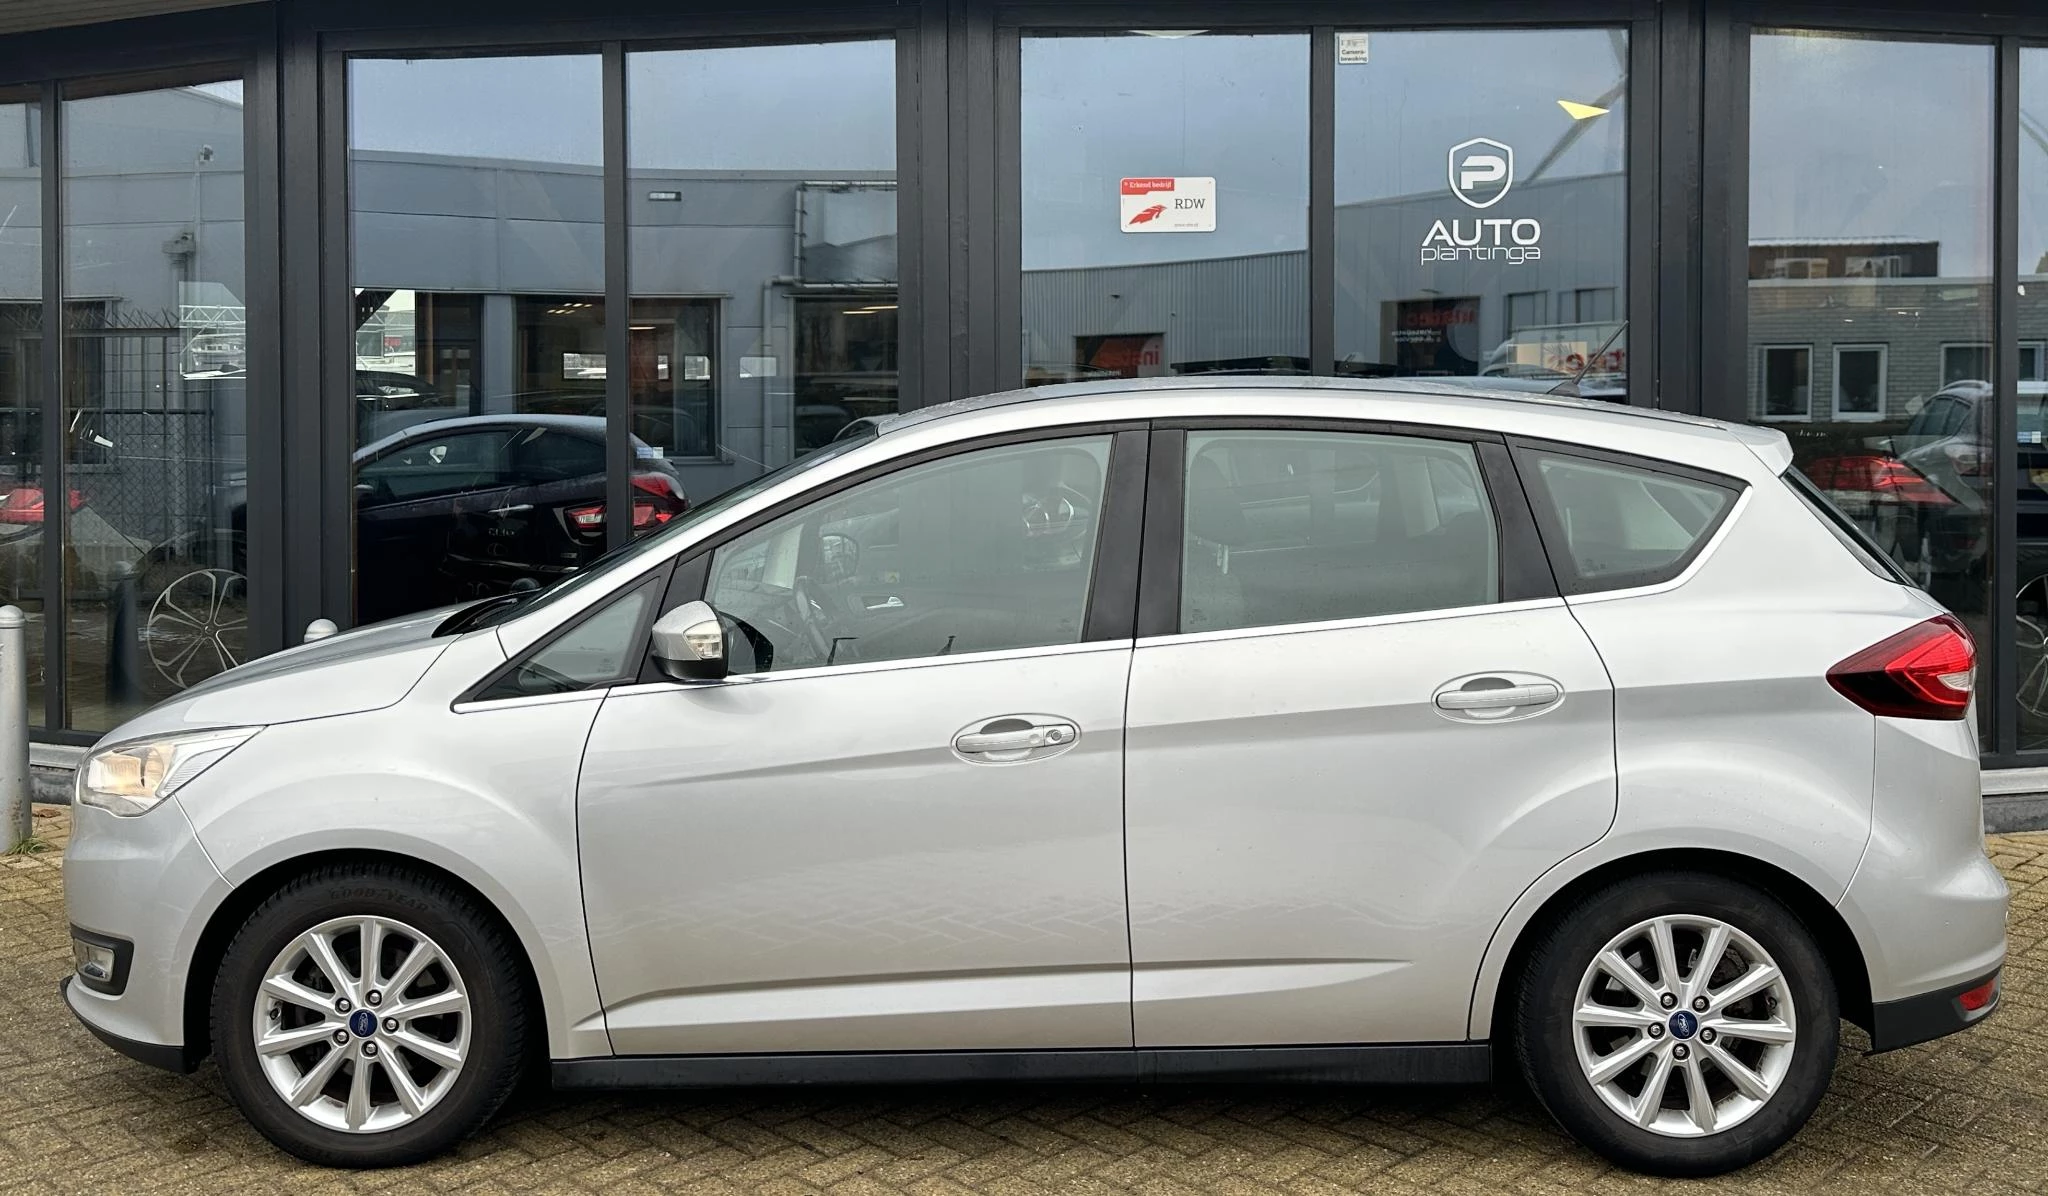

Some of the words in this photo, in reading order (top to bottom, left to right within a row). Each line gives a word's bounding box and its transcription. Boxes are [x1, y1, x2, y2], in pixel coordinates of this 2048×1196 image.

[1460, 155, 1507, 190] P
[1174, 198, 1206, 210] RDW
[1421, 218, 1541, 247] AUTO
[1420, 244, 1541, 266] plantinga
